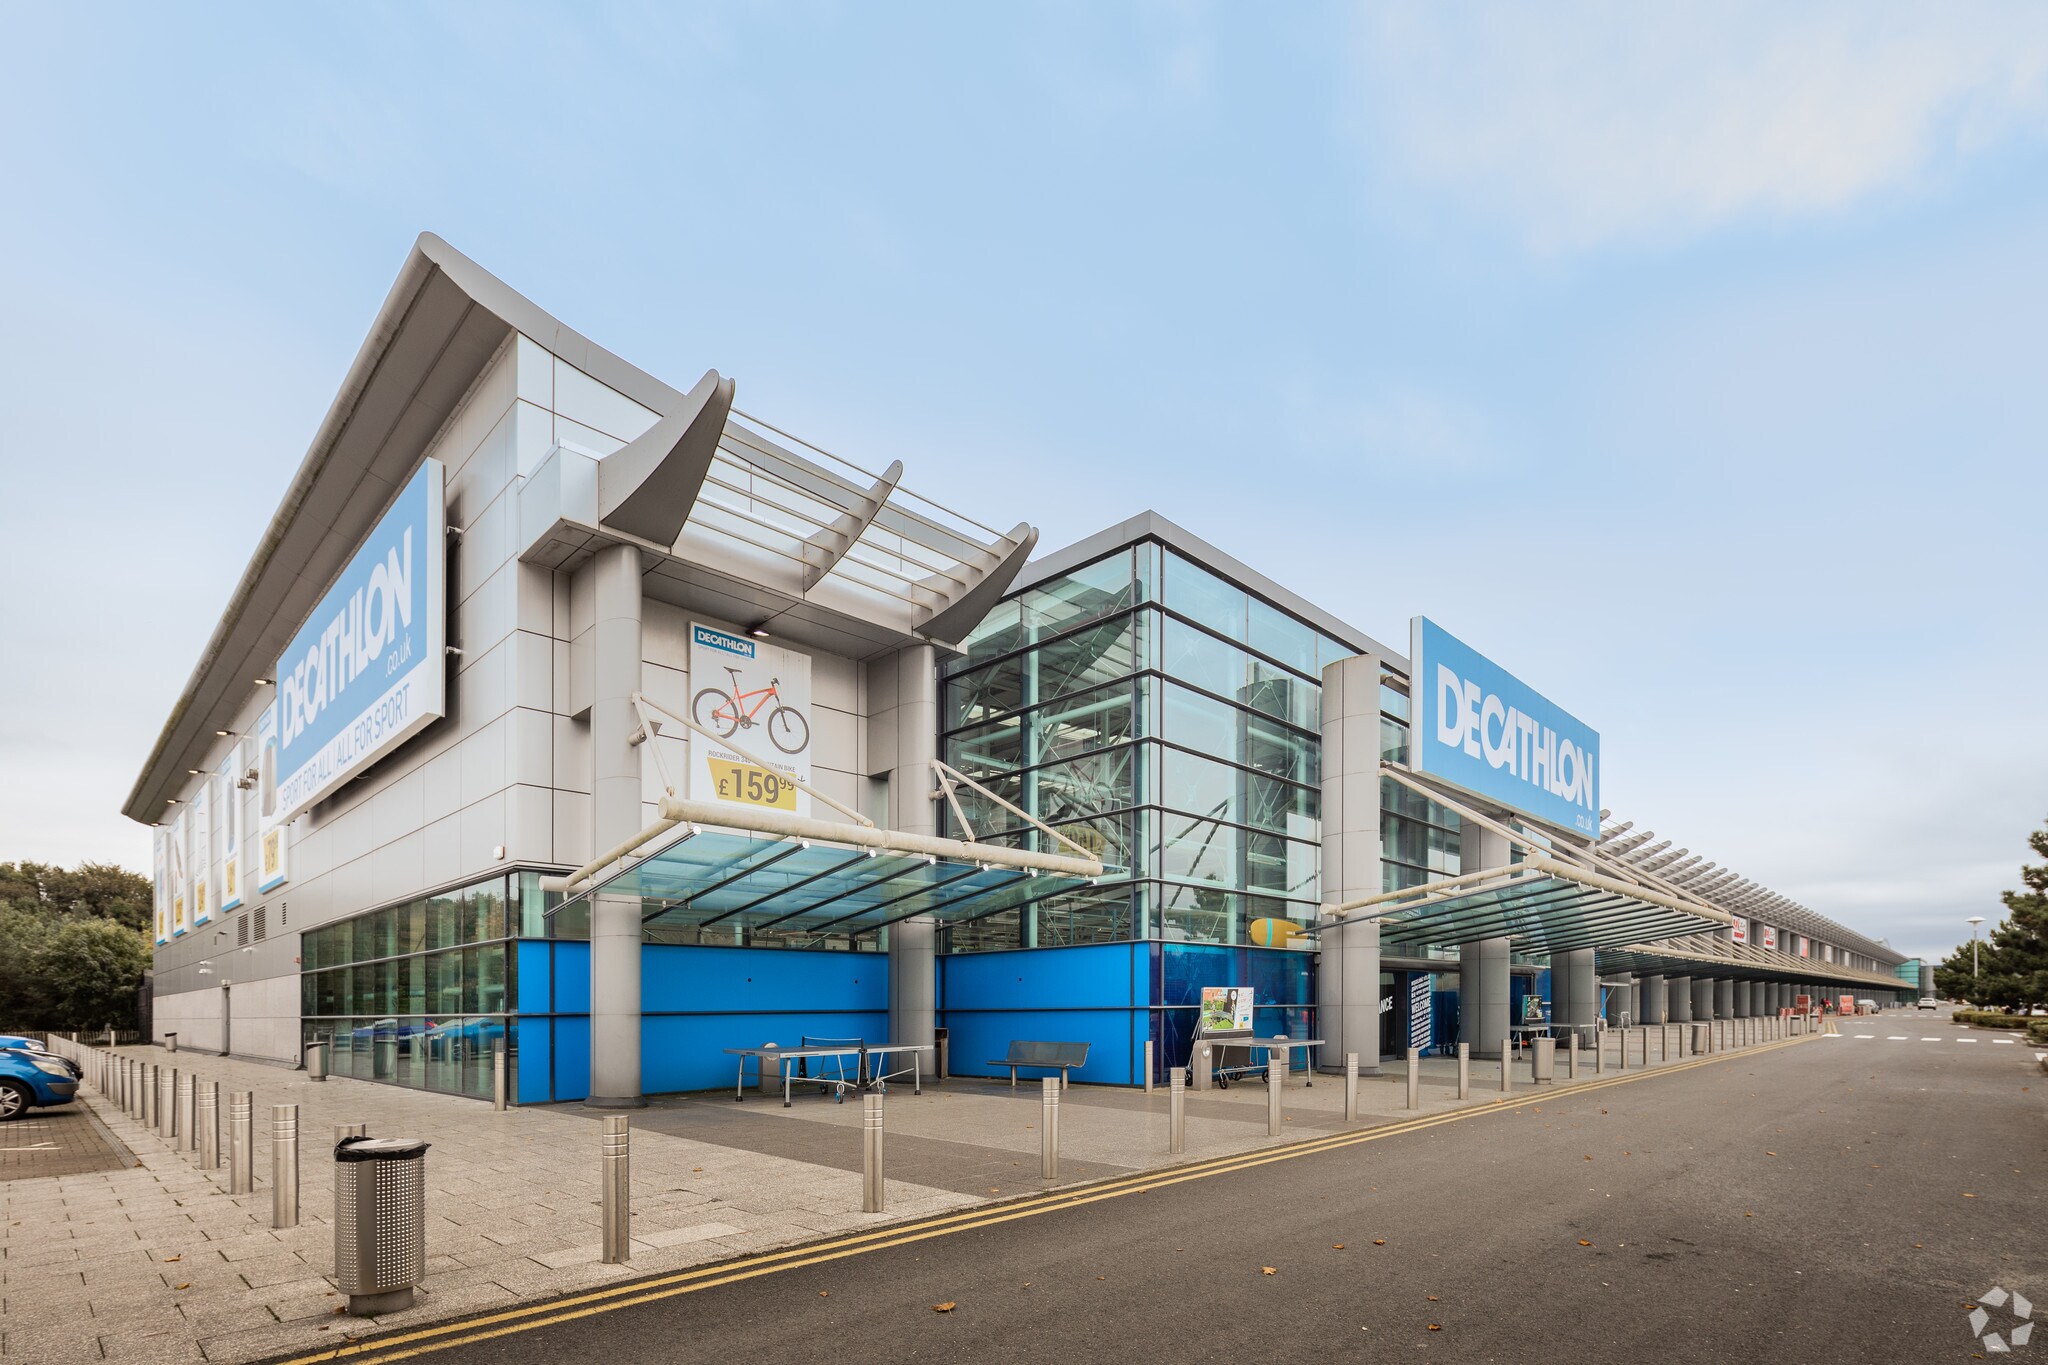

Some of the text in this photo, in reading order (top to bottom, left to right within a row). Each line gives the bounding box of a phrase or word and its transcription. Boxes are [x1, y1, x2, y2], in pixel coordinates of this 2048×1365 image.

[282, 525, 412, 750] DECATHLON
[385, 632, 412, 679] .co.uk
[697, 630, 752, 655] DECATHLON
[282, 683, 410, 811] SPORT FOR ALL ALL FOR SPORT
[1437, 662, 1593, 811] DECATHLON
[708, 750, 740, 762] ROCKRIDER
[784, 764, 796, 773] BIKE
[1411, 996, 1431, 1015] WELCOME
